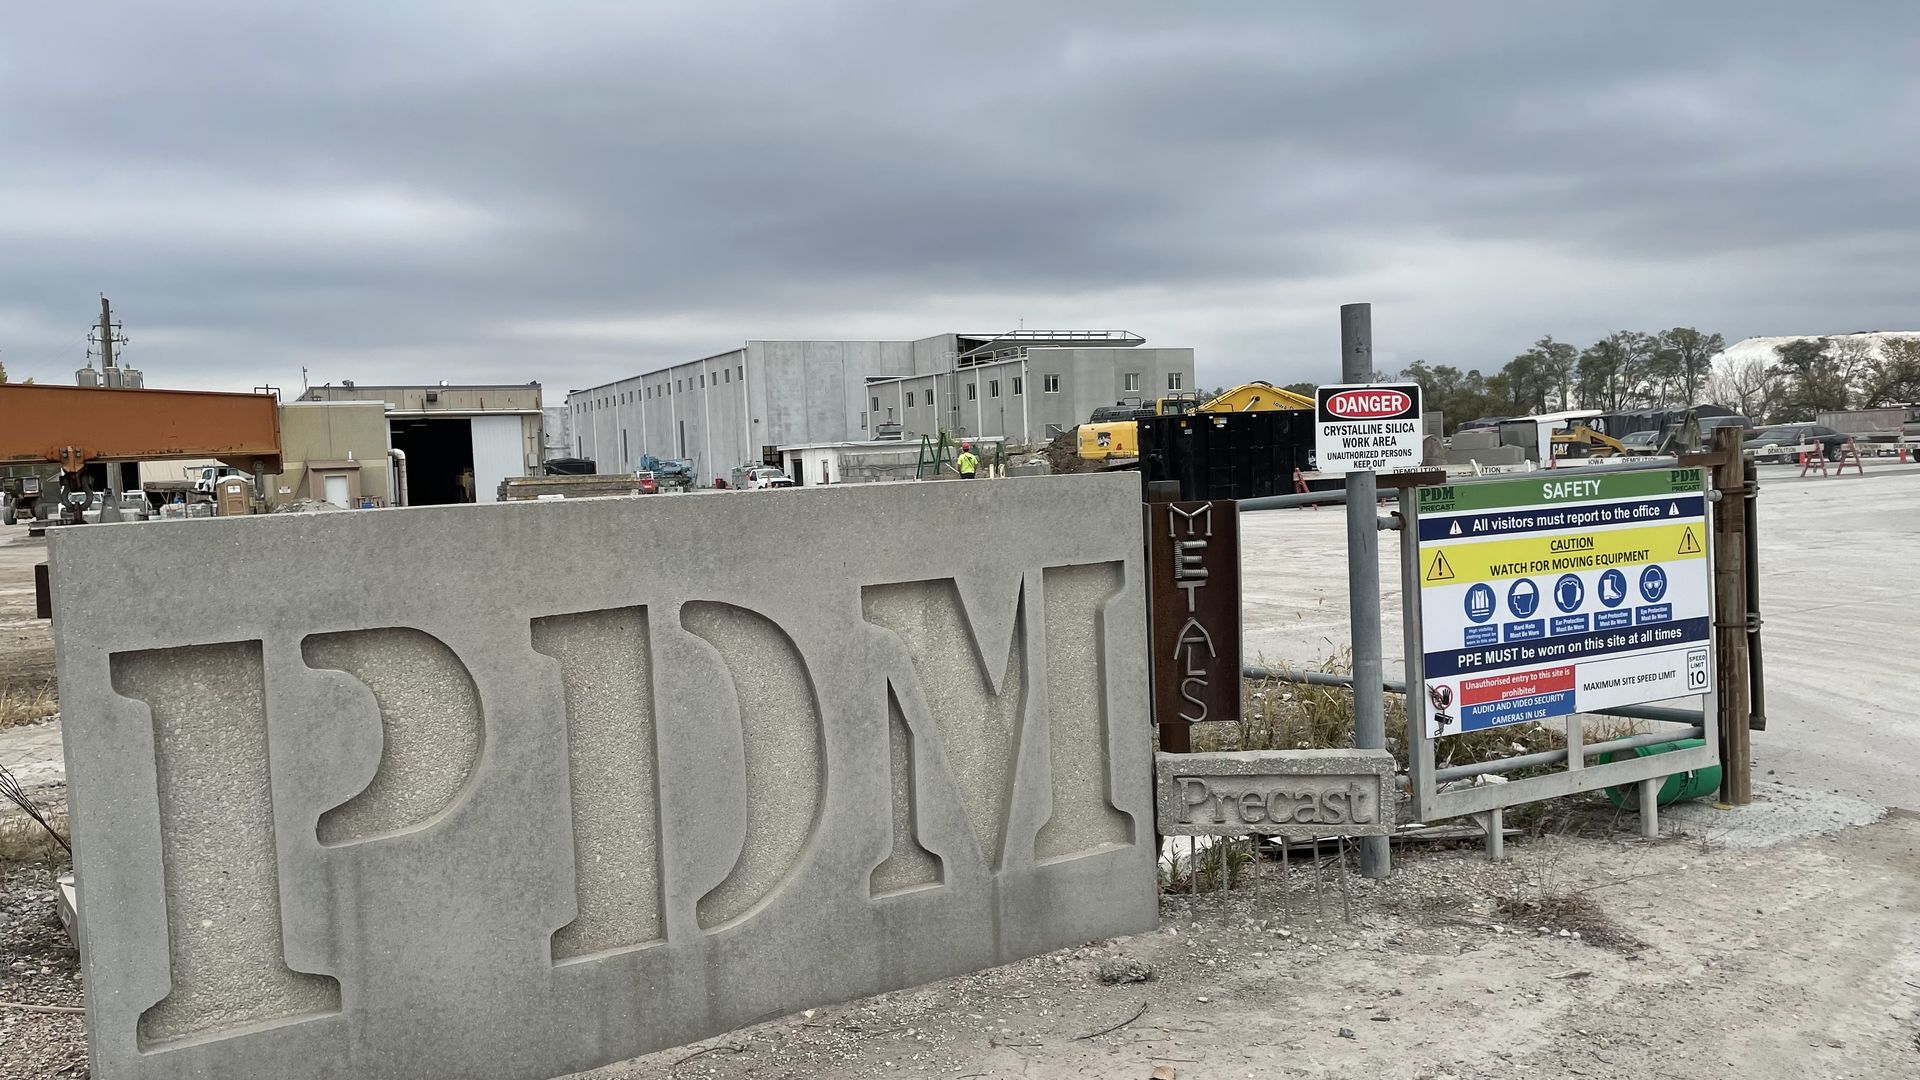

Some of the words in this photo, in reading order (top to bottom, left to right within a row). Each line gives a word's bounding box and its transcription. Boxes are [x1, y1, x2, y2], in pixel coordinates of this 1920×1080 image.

[1335, 395, 1403, 414] DANGER
[1323, 424, 1383, 436] CRYSTALLINE
[1385, 422, 1415, 434] SILICA
[1342, 437, 1370, 448] WORK
[1372, 436, 1397, 446] AREA
[1552, 443, 1569, 456] CAT
[1327, 450, 1379, 460] UNAUTHORIZED
[1381, 448, 1412, 457] PERSONS
[1767, 447, 1797, 455] DEMOLITION
[1354, 460, 1370, 468] KEEP
[1372, 459, 1386, 467] OUT
[1671, 469, 1700, 483] PDM
[1420, 486, 1455, 502] PDM
[1542, 480, 1601, 500] SAFETY
[1671, 484, 1700, 492] PRECAST
[1421, 503, 1455, 512] PRECAST
[1472, 518, 1488, 532] All
[1491, 516, 1534, 530] visitors
[1537, 513, 1565, 526] must
[1567, 510, 1599, 526] report
[1601, 509, 1612, 520] to
[1614, 507, 1630, 519] the
[1633, 505, 1660, 517] office
[1550, 537, 1594, 551] CAUTION
[1490, 562, 1527, 576] WATCH
[1530, 560, 1550, 572] FOR
[1552, 556, 1593, 570] MOVING
[1595, 550, 1650, 566] EQUIPMENT
[1168, 501, 1216, 723] METALS
[1458, 653, 1482, 668] PPE
[1485, 648, 1518, 664] MUST
[1521, 647, 1535, 659] be
[1538, 644, 1565, 657] worn
[1568, 641, 1582, 653] on
[1584, 637, 1604, 651] this
[1607, 635, 1626, 646] site
[1628, 633, 1638, 644] at
[1641, 630, 1652, 642] all
[1655, 628, 1682, 640] times
[1466, 676, 1510, 690] Unauthorised
[1512, 673, 1529, 684] entry
[1539, 670, 1551, 679] this
[1552, 669, 1563, 678] site
[1584, 679, 1621, 691] MAXIMUM
[1622, 676, 1636, 686] SITE
[1637, 673, 1657, 683] SPEED
[1658, 670, 1676, 680] LIMIT
[1690, 671, 1706, 686] 10
[1502, 685, 1536, 699] prohibited
[1472, 704, 1495, 715] AUDIO
[1496, 702, 1511, 711] AND
[1512, 698, 1533, 709] VIDEO
[1534, 693, 1565, 705] SECURITY
[1491, 712, 1524, 725] CAMERAS
[1525, 711, 1533, 720] IN
[1534, 709, 1547, 718] USE
[108, 560, 1136, 1055] PDM
[1176, 776, 1372, 824] Precast
